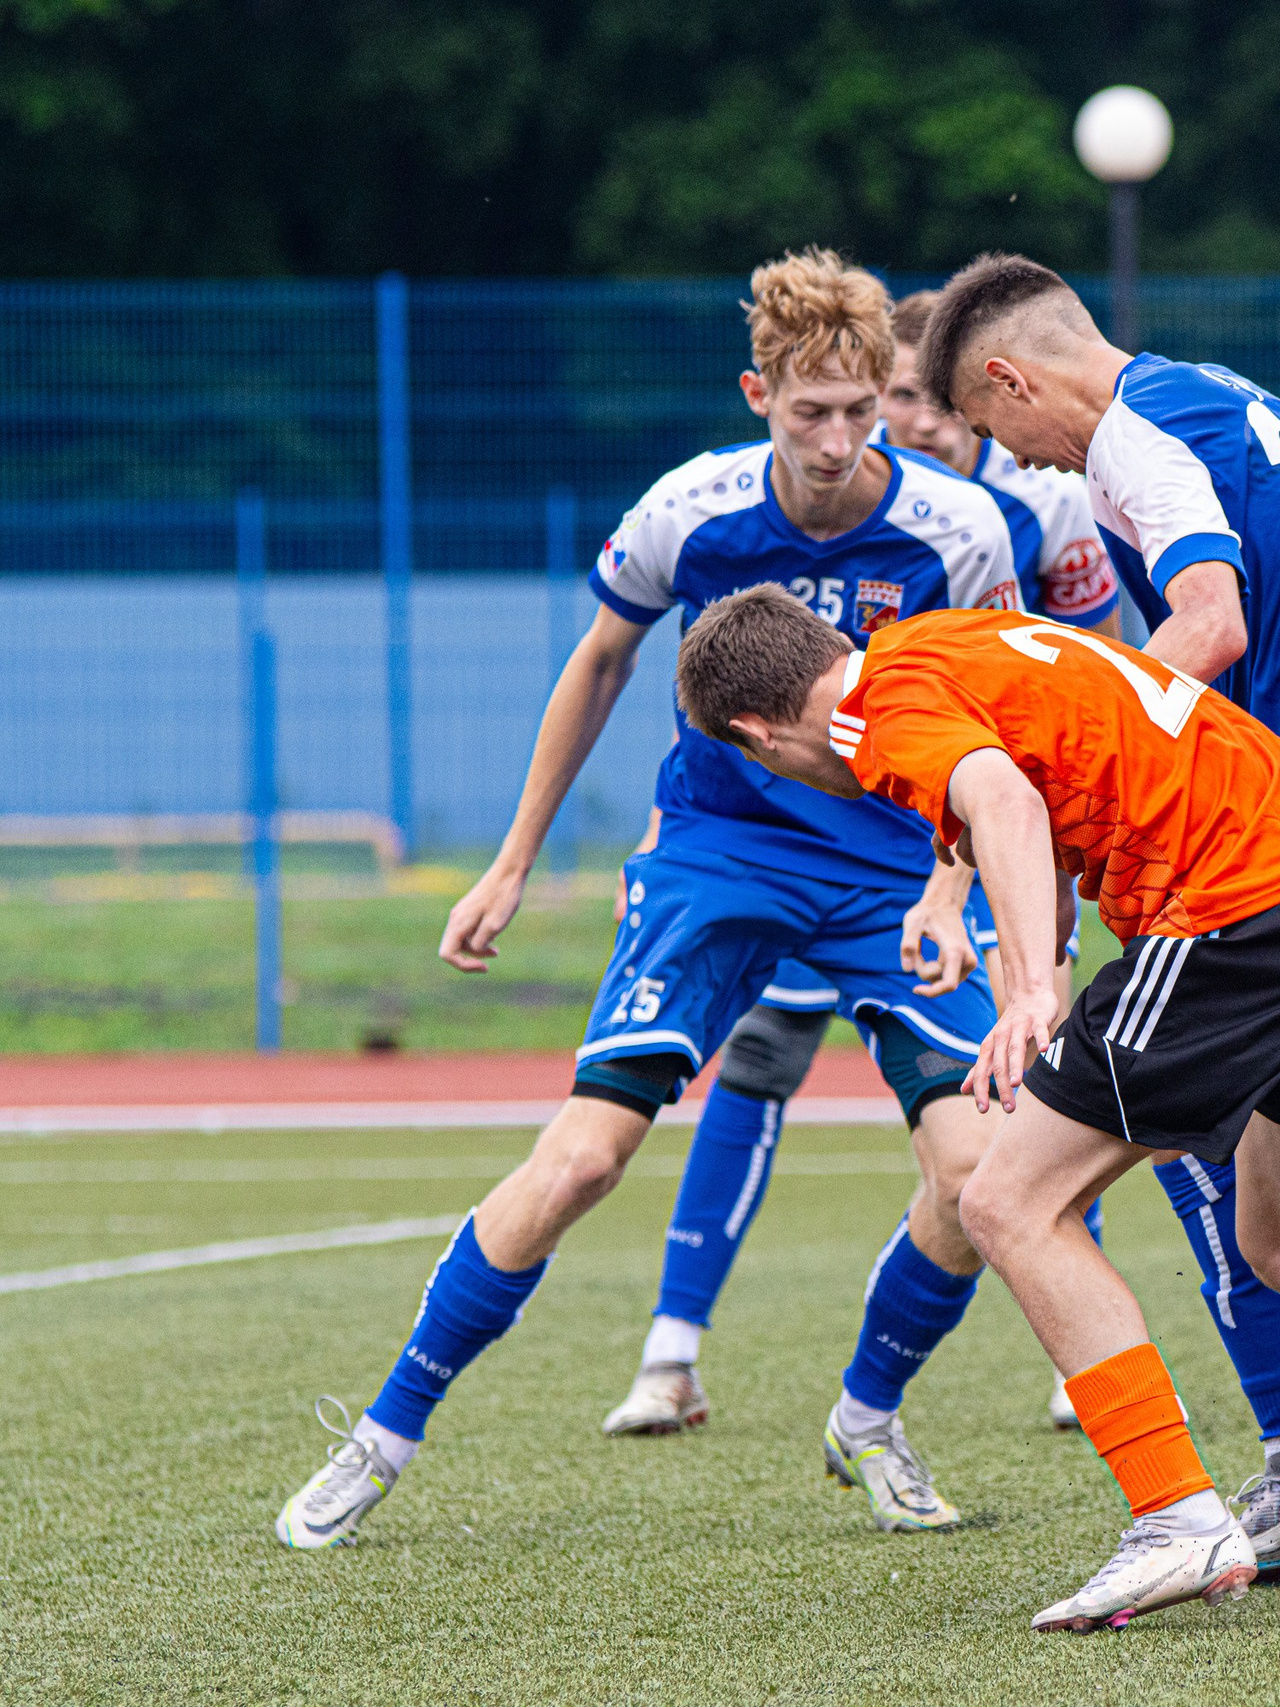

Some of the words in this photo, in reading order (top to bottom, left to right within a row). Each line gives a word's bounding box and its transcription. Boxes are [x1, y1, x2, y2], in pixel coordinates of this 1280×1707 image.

[788, 576, 845, 626] 25
[998, 618, 1205, 739] 2
[406, 1345, 453, 1379] JAKO
